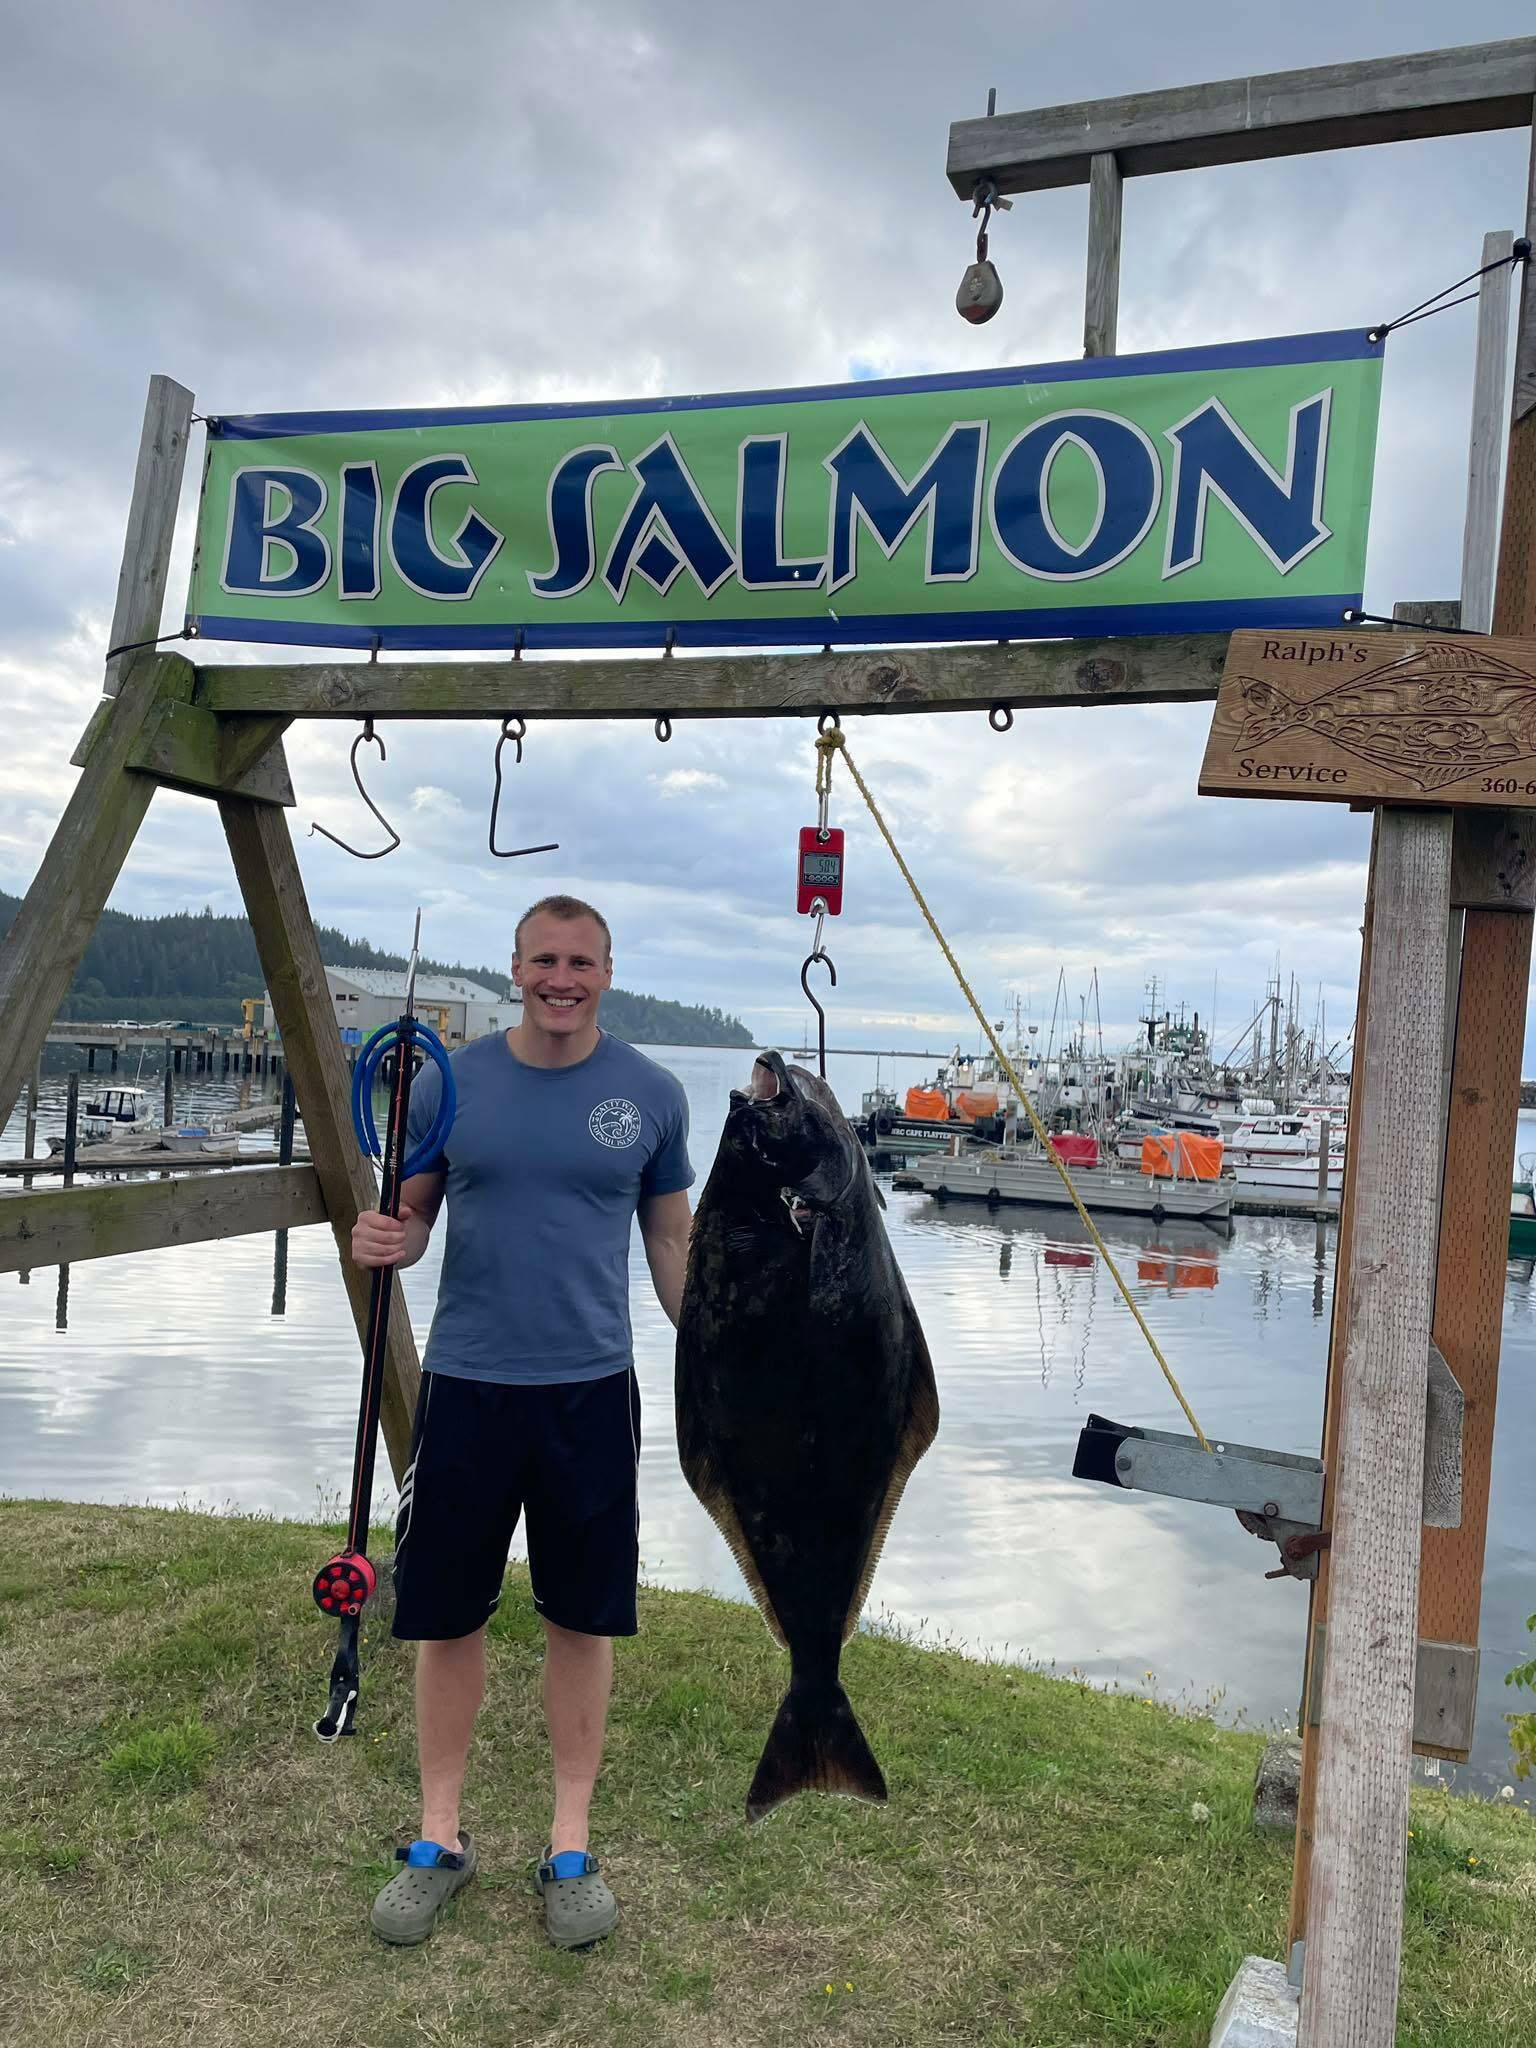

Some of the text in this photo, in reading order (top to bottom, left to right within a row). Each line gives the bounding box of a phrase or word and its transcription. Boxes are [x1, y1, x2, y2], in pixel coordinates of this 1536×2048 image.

[219, 387, 1333, 602] BIG SALMON
[1262, 640, 1368, 666] Ralph's
[1237, 758, 1348, 783] Service
[1480, 777, 1536, 795] 360-6
[595, 1100, 620, 1116] SALTY
